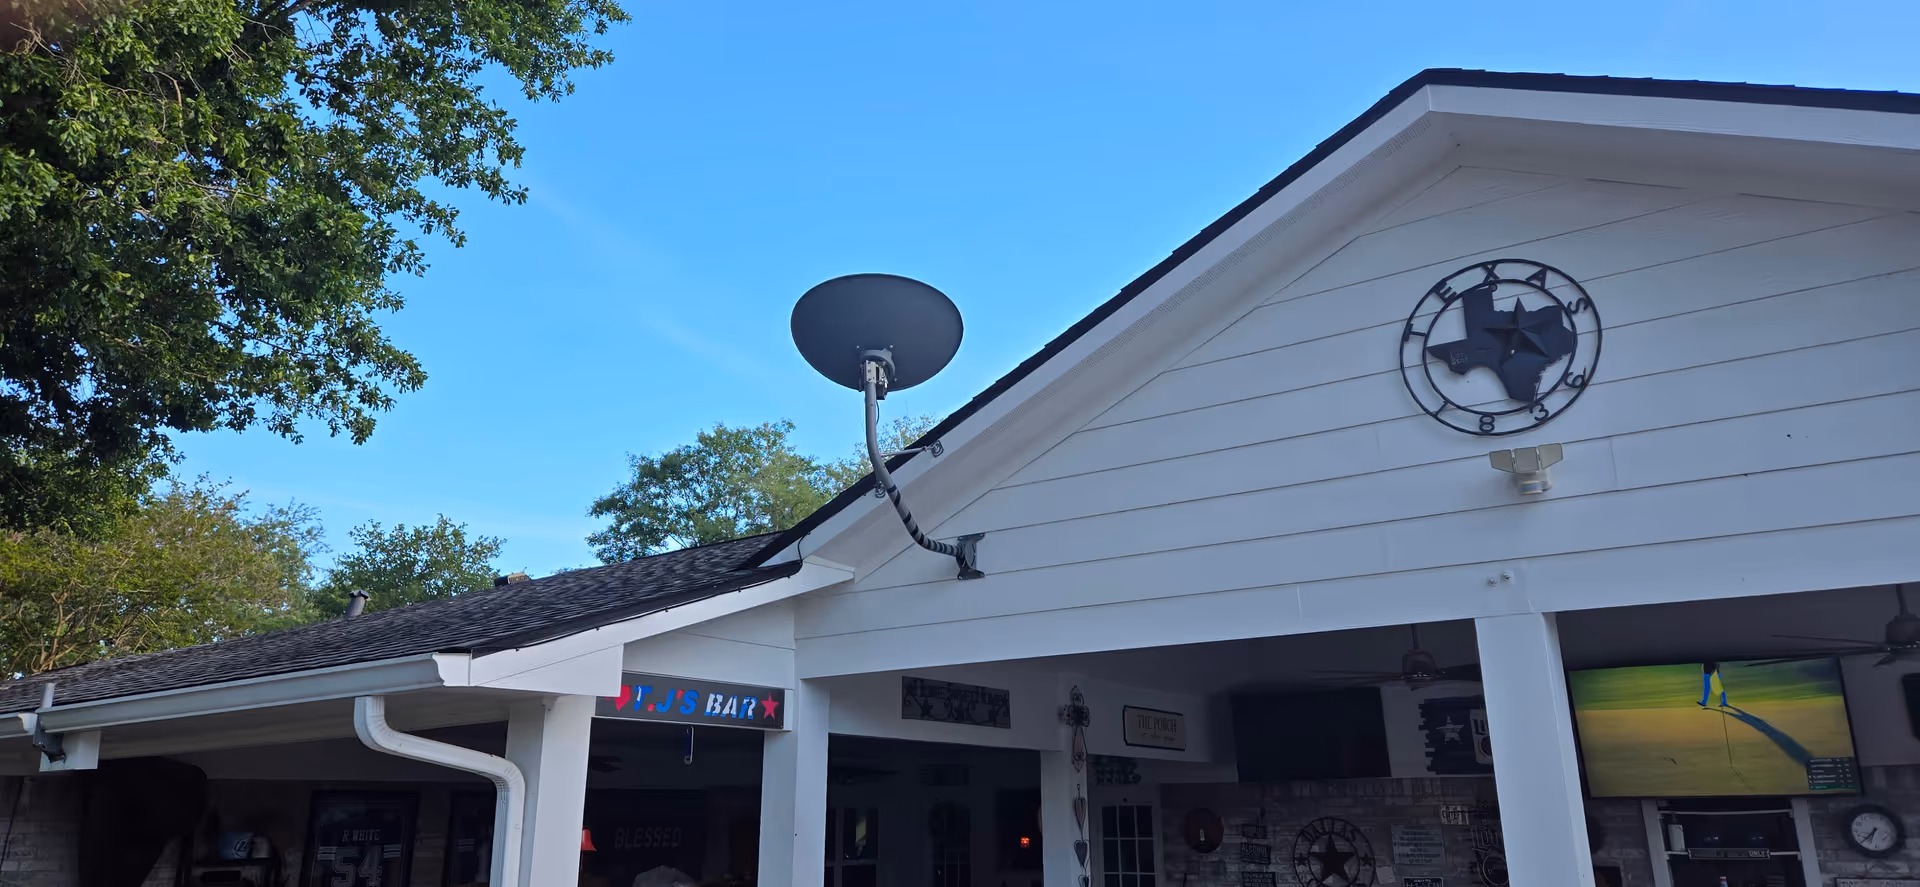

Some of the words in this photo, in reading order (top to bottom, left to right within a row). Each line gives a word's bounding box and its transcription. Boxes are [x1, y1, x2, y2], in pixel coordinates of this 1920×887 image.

[1403, 263, 1590, 342] TEXAS
[1433, 368, 1588, 434] 1836
[704, 693, 757, 719] BAR
[1154, 716, 1177, 733] PORCH
[352, 828, 381, 840] WHITE
[614, 827, 682, 850] BLESSED
[1301, 818, 1356, 842] DALLAS
[331, 846, 382, 887] 54
